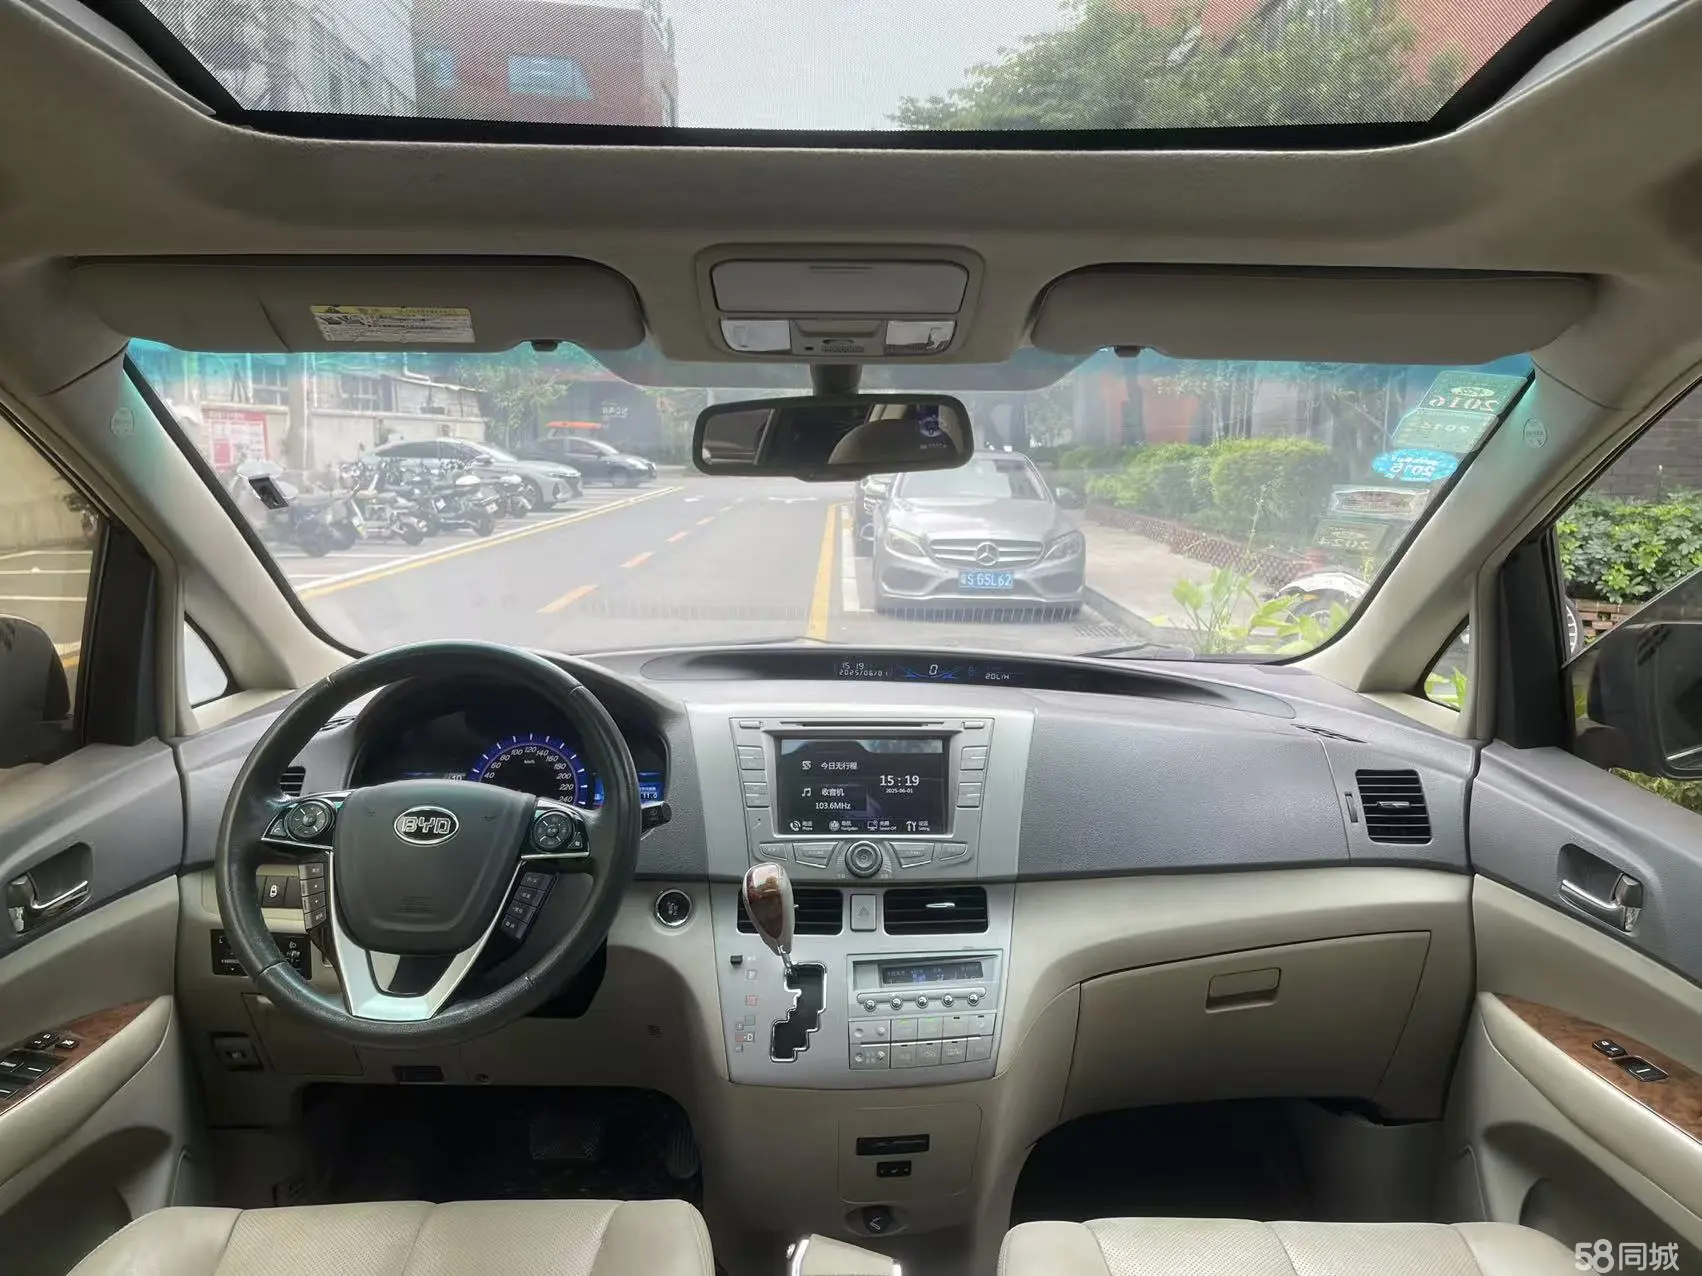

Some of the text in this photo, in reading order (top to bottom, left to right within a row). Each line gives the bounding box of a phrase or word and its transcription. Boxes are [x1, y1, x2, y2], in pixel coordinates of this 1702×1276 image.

[929, 664, 938, 676] 0
[536, 749, 549, 757] 140
[500, 754, 511, 762] 80
[484, 771, 495, 779] 40
[556, 772, 572, 780] 200
[559, 783, 574, 791] 220
[821, 788, 845, 796] 收音机
[559, 795, 573, 803] 240
[815, 802, 851, 810] 103.6MHz
[401, 816, 451, 834] BYD
